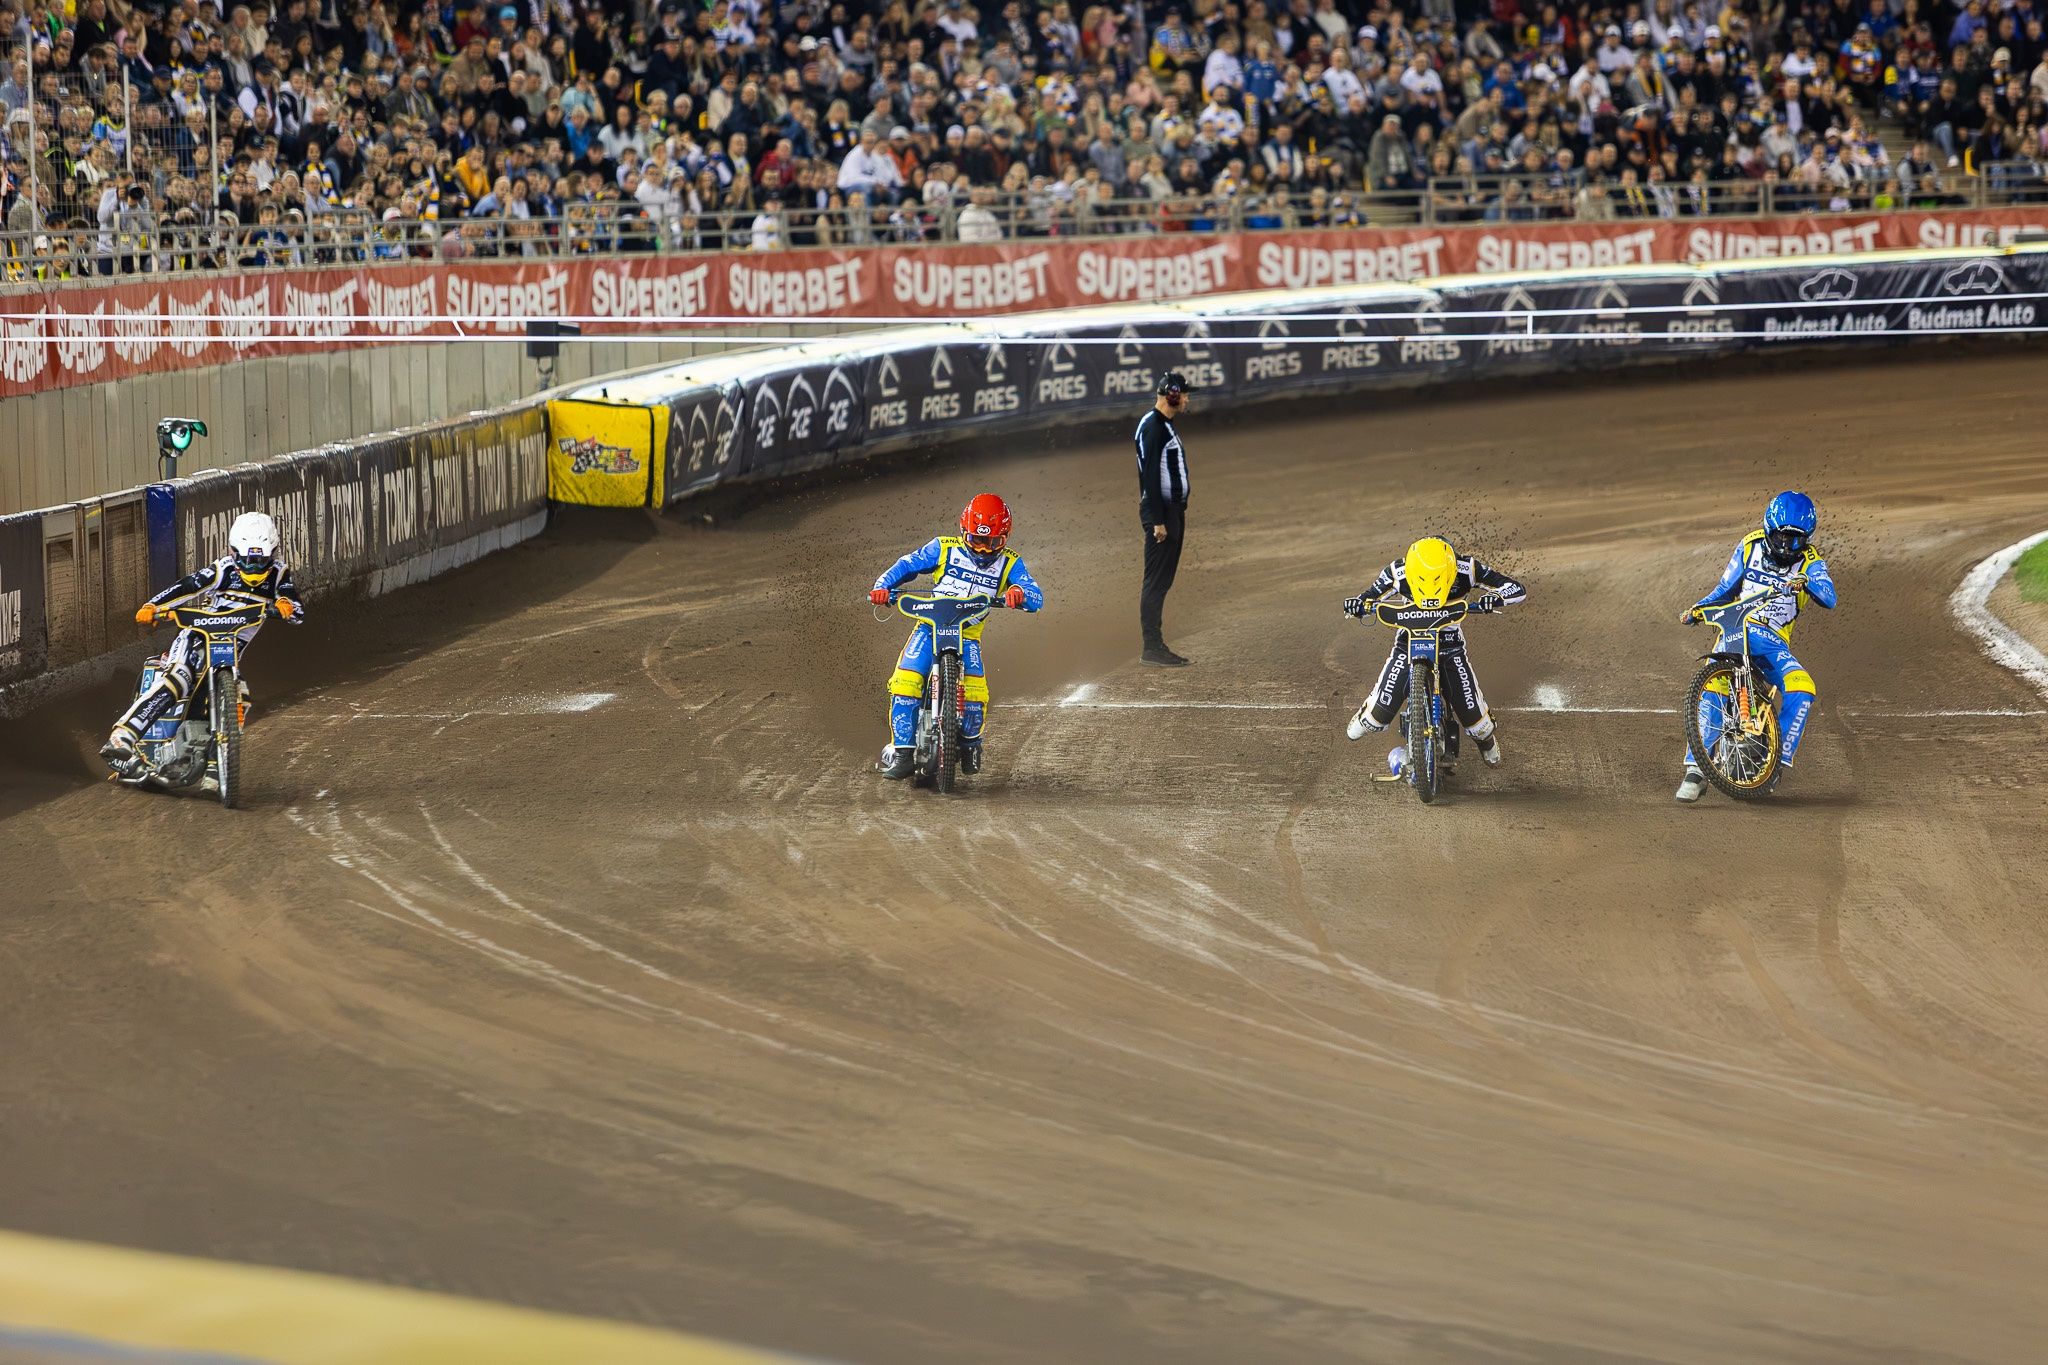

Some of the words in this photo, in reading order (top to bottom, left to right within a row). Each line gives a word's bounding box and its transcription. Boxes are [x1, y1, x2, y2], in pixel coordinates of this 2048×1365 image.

[1077, 243, 1228, 300] SUPERBET
[1257, 237, 1444, 287] SUPERBET
[592, 263, 710, 317] SUPERBET
[729, 258, 864, 316] SUPERBET
[894, 251, 1050, 310] SUPERBET
[368, 274, 437, 336] SUPERBET
[1908, 304, 1983, 330] Budmat
[1986, 302, 2036, 326] Auto
[1667, 318, 1735, 344] PRES
[1841, 311, 1887, 333] Auto
[1246, 350, 1302, 382] PRES
[1322, 342, 1380, 371] PRES
[1401, 339, 1460, 364] PRES
[1039, 375, 1088, 403] PRES
[1104, 367, 1154, 398] PRES
[921, 393, 961, 421] PRES
[974, 385, 1019, 414] PRES
[869, 400, 907, 429] PRES
[194, 616, 247, 627] BOGDANKA
[912, 603, 934, 611] LAVOR
[1397, 610, 1450, 620] BOGDANKA
[1386, 653, 1407, 693] maspo
